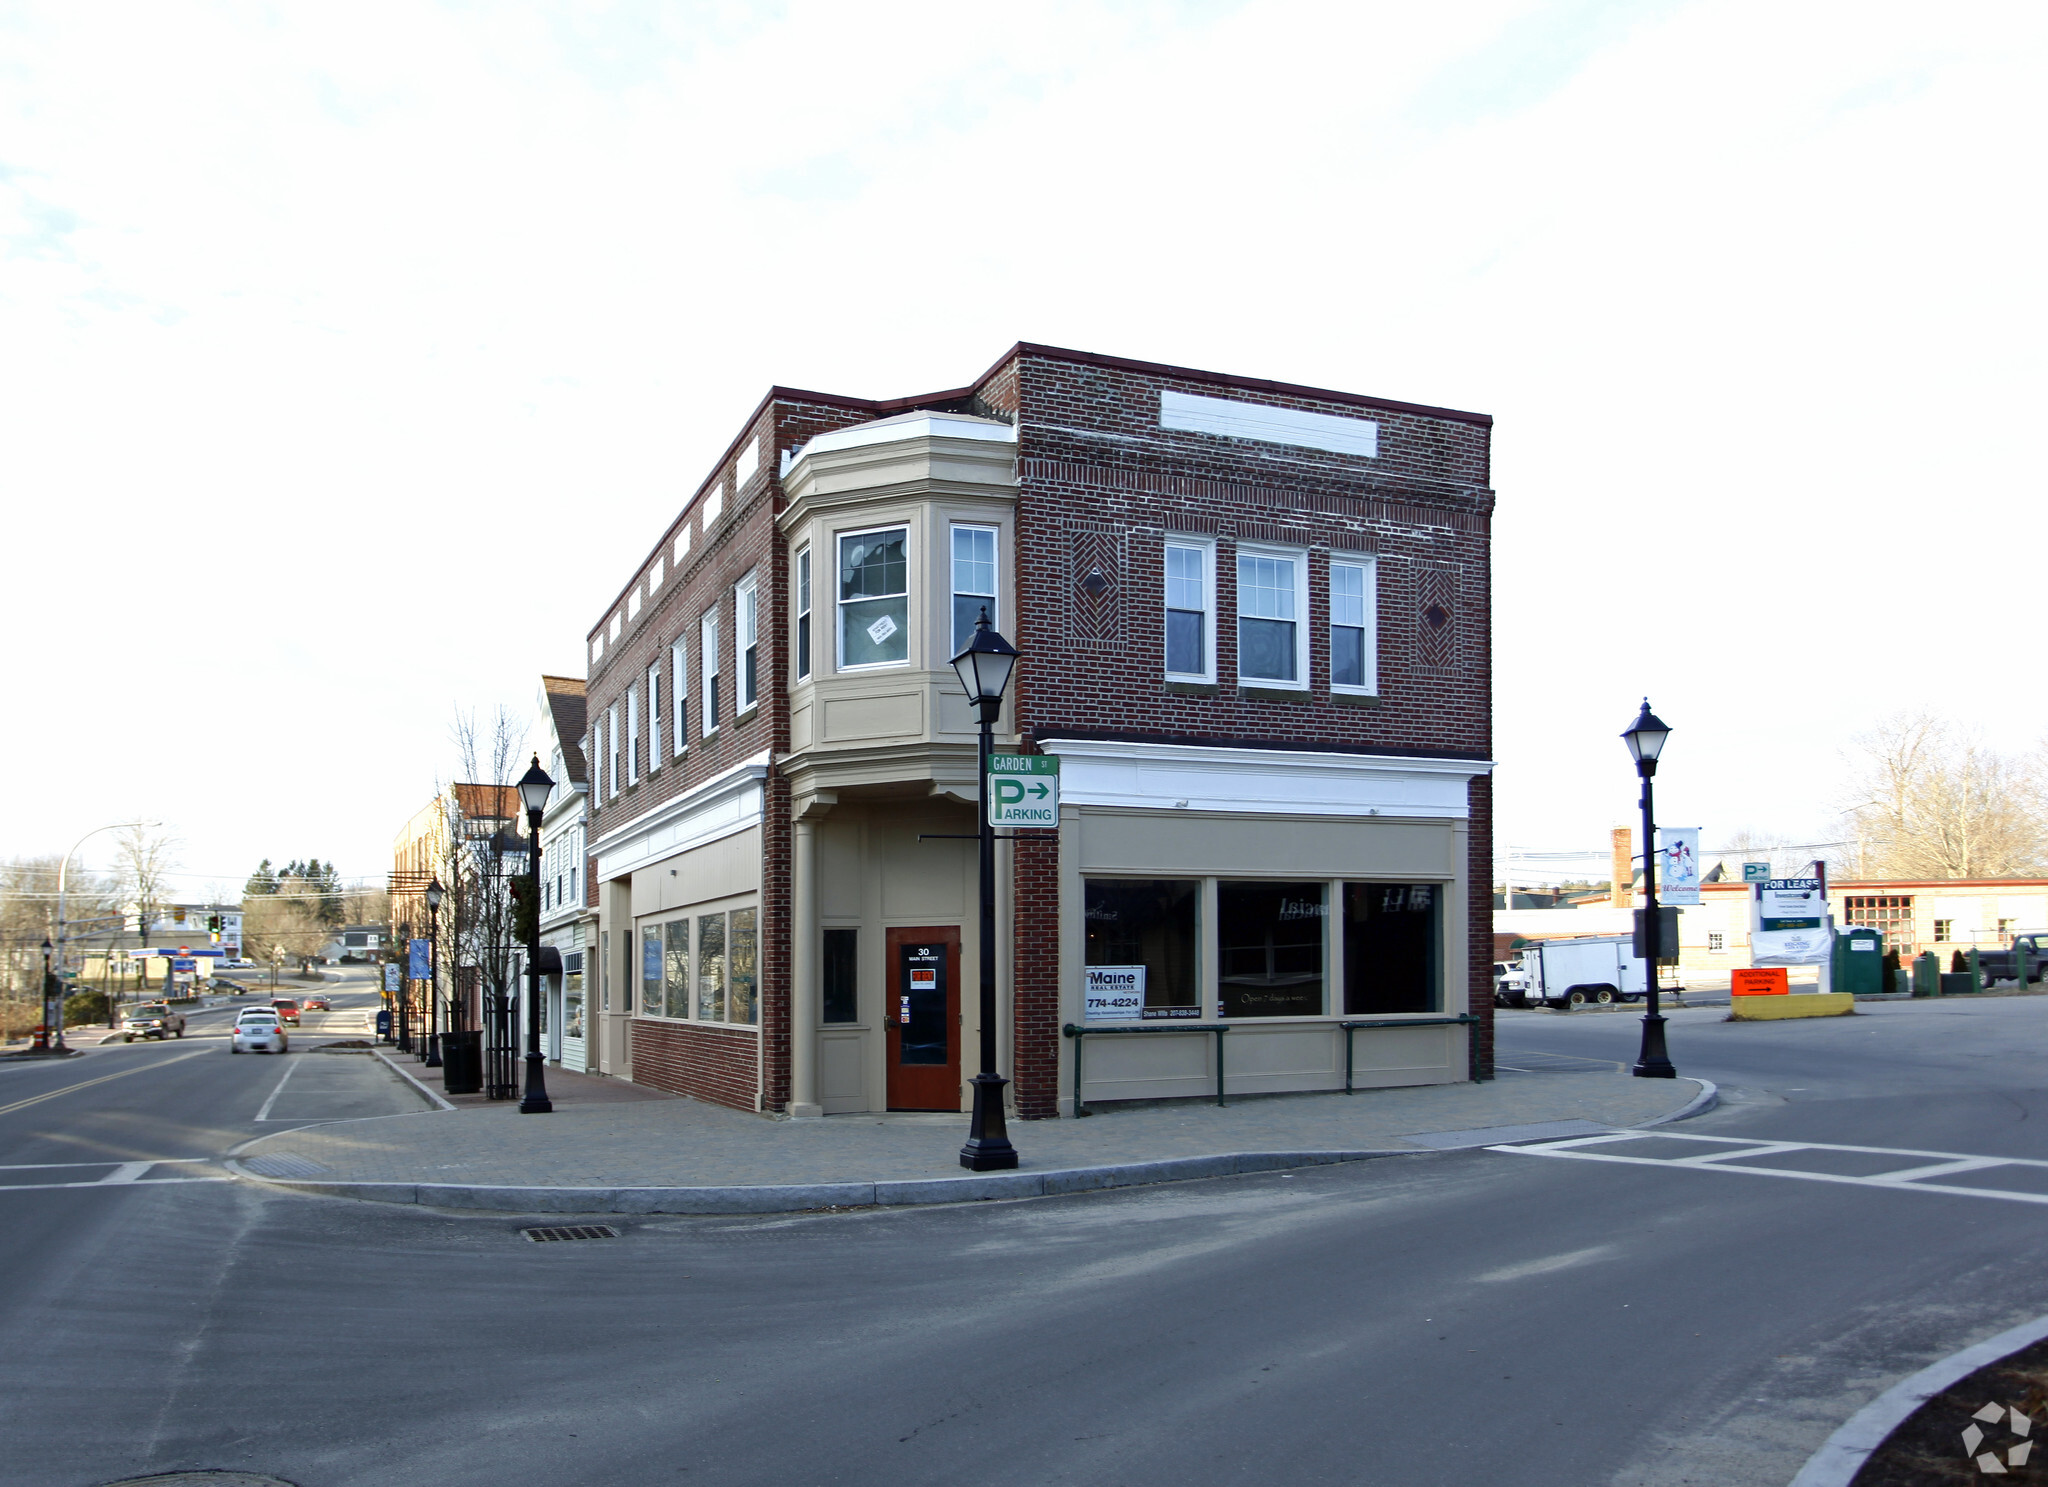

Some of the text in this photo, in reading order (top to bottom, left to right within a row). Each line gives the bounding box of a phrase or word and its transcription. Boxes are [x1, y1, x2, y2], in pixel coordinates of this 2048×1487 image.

[993, 756, 1032, 771] GARDEN
[1662, 884, 1698, 892] Welcome
[1764, 880, 1785, 889] FOR
[917, 948, 930, 956] 30
[1090, 971, 1136, 984] Maine
[1087, 998, 1139, 1008] 774-4224
[1241, 993, 1263, 1004] Open
